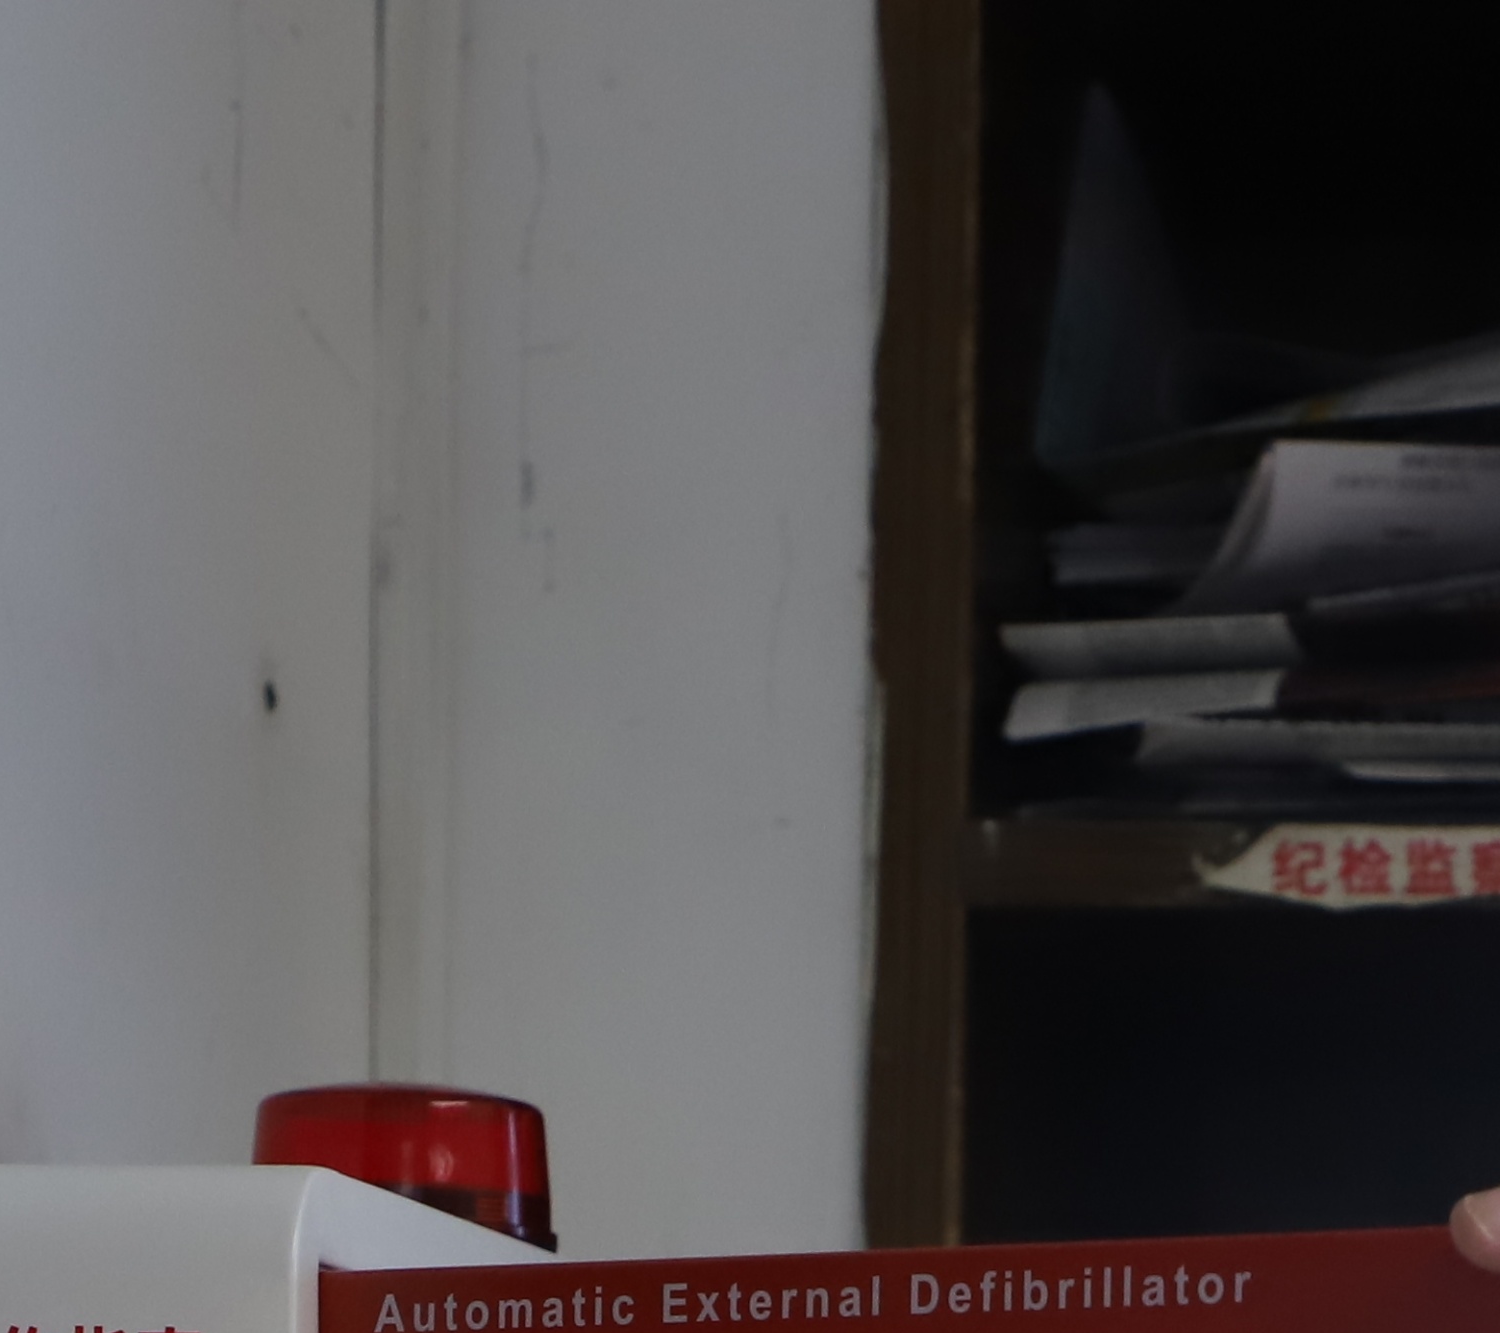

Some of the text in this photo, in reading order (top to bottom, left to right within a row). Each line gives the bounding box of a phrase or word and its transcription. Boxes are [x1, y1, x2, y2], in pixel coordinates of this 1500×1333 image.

[374, 1266, 1251, 1333] Automatic External Defibrillator
